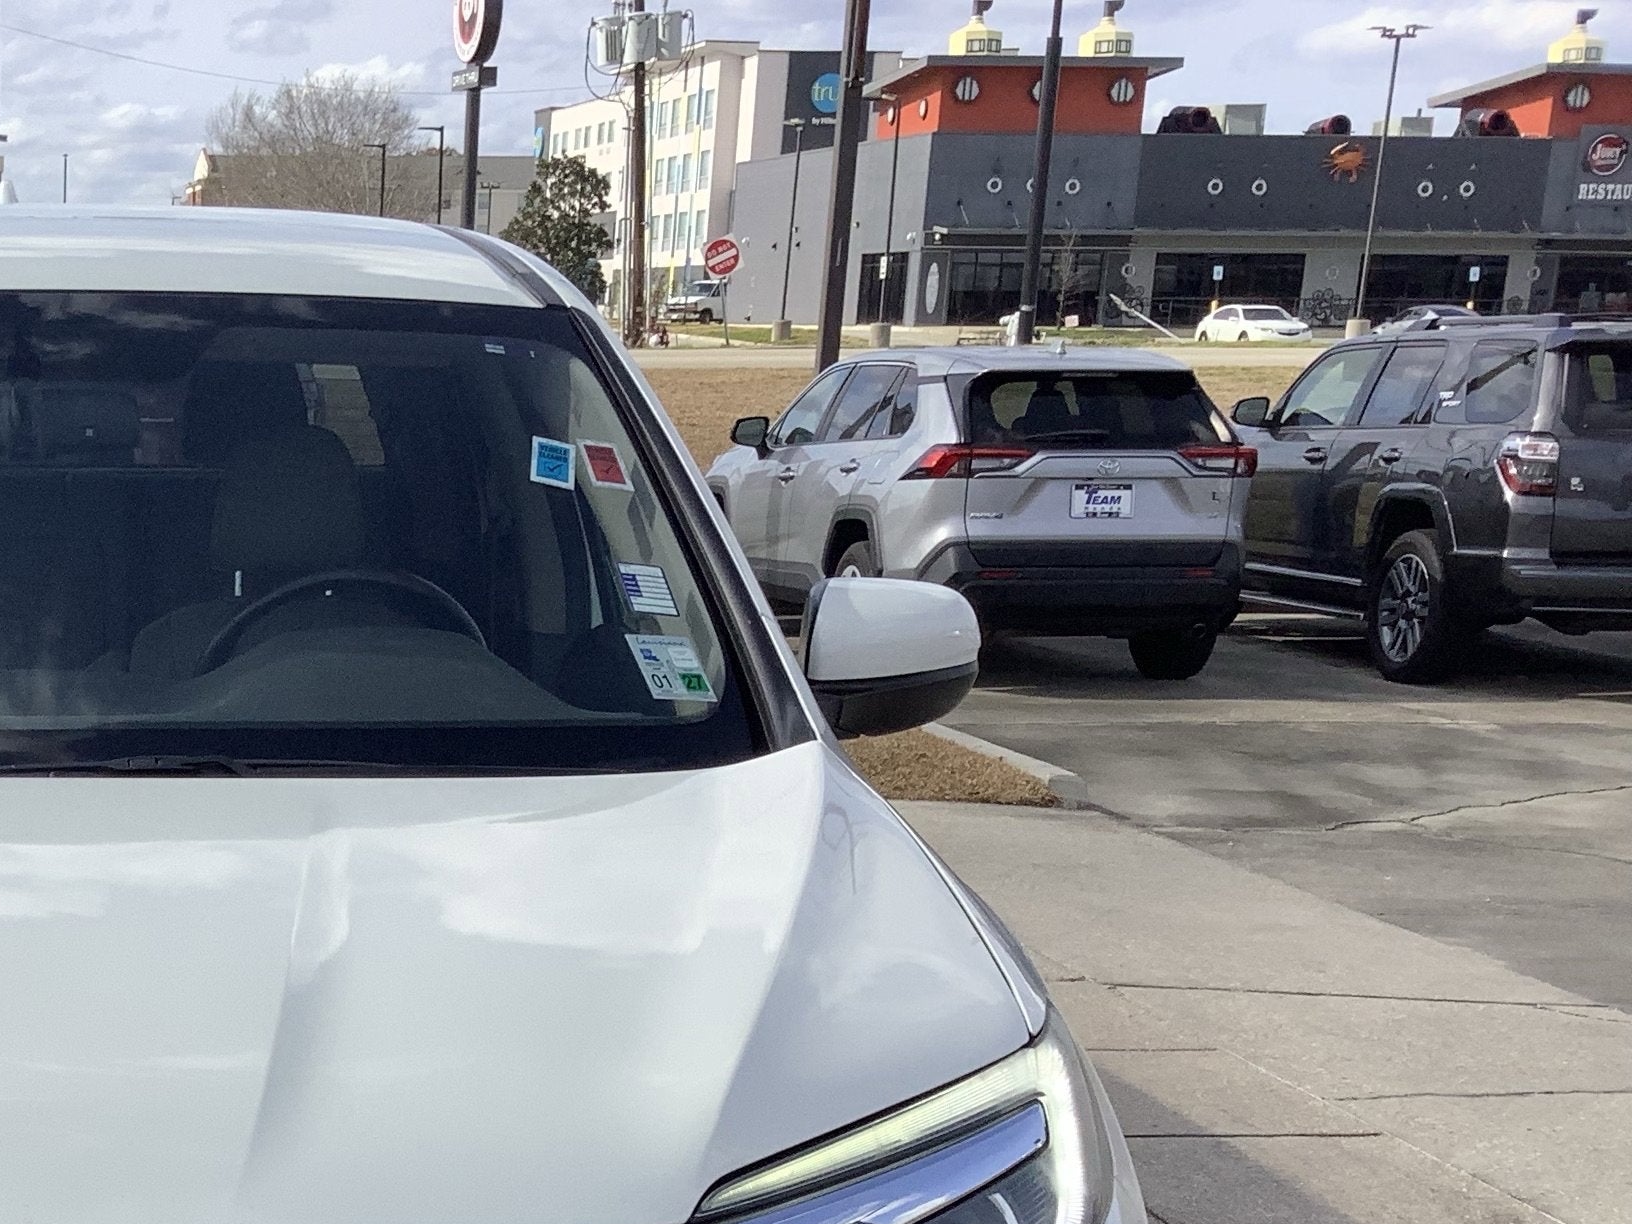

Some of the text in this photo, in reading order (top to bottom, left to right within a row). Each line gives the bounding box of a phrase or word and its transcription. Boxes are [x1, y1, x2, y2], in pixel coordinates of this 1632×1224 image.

[707, 242, 731, 258] DO NOT
[715, 258, 735, 271] ENTER
[651, 673, 673, 689] 01
